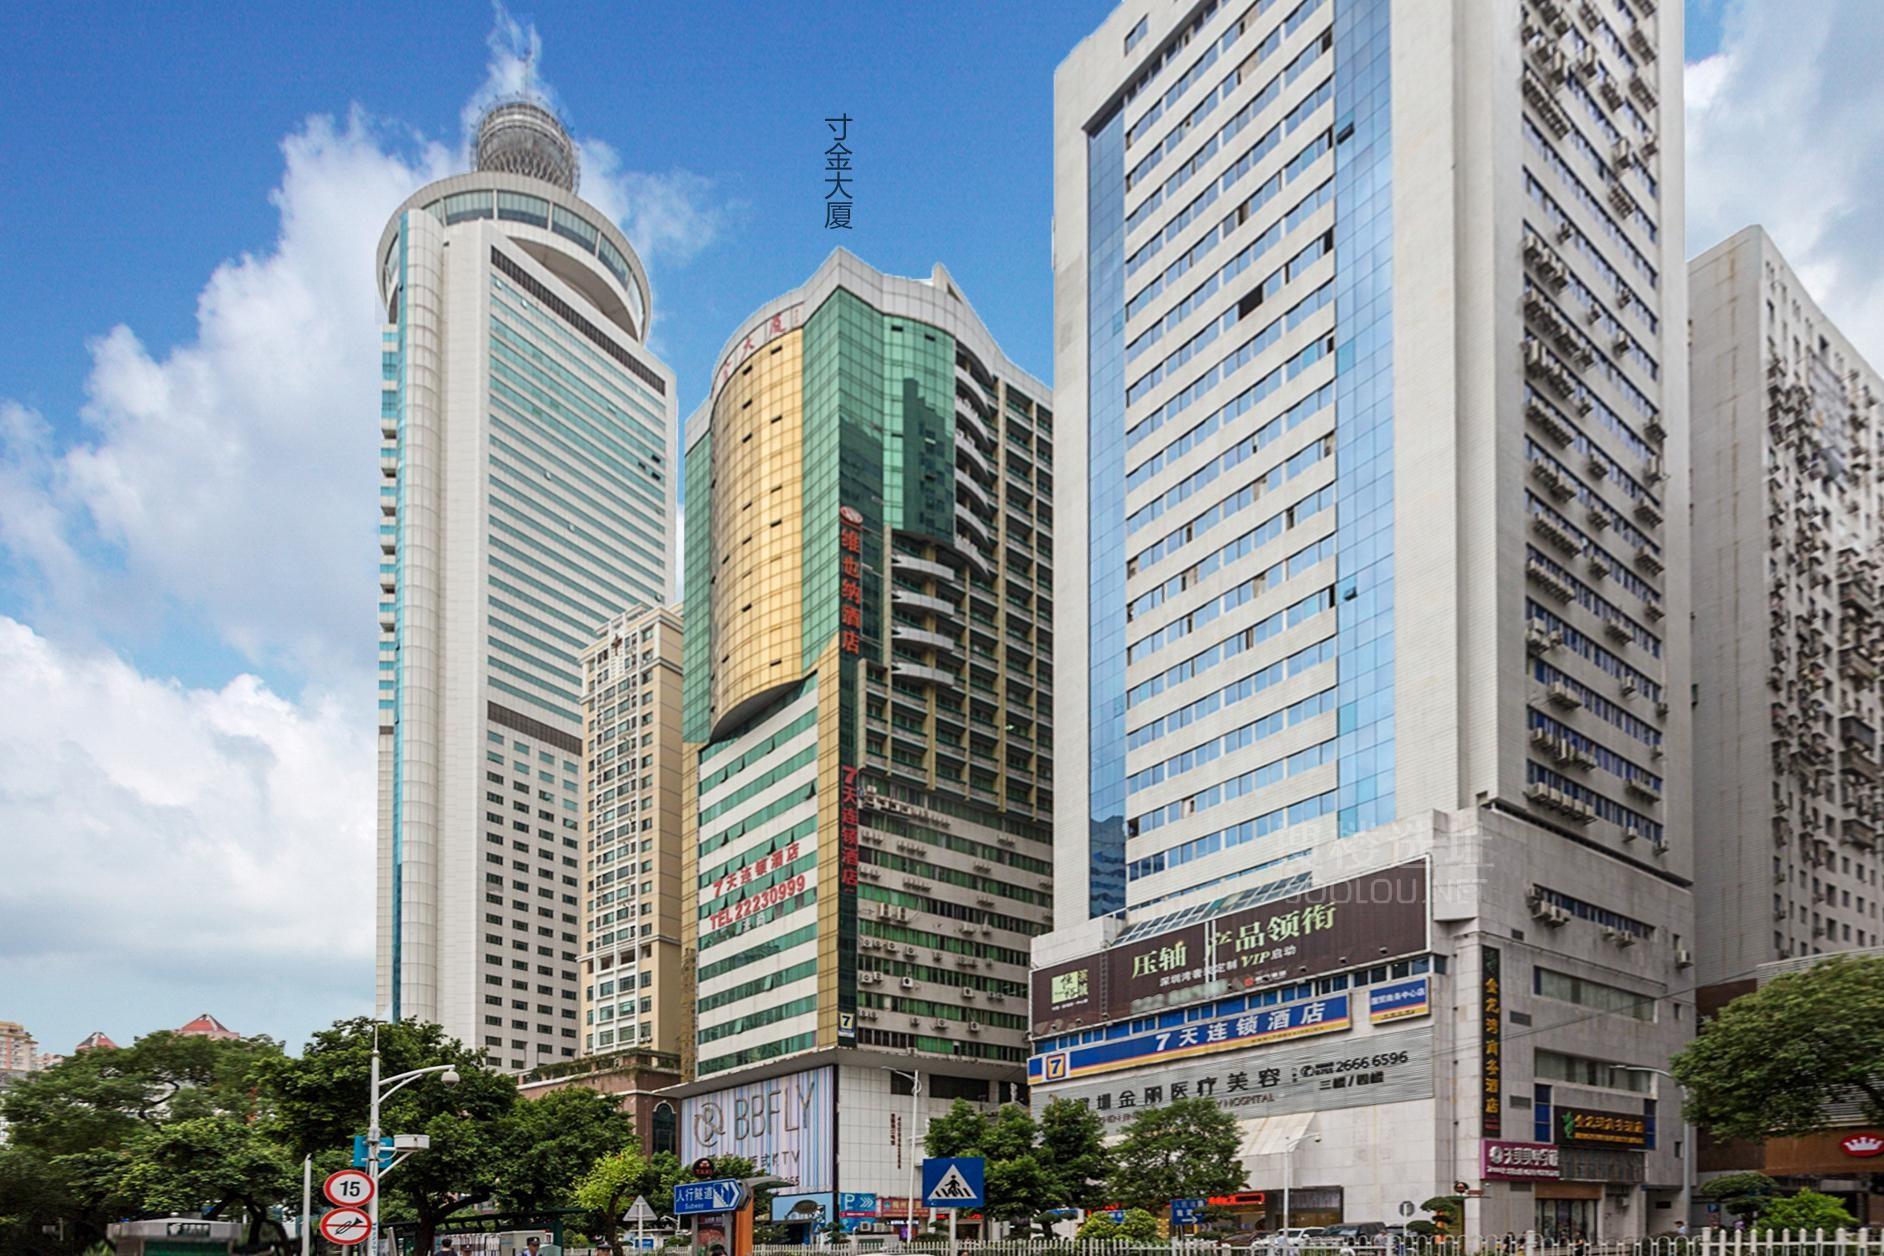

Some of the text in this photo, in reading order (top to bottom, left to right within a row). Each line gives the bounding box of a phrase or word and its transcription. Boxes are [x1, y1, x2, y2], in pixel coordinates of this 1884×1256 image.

[841, 528, 861, 656] 维也纳酒店
[842, 765, 858, 886] 7天连锁酒店
[713, 843, 800, 898] 7天连锁酒店
[710, 874, 806, 929] TEL 22230999
[1241, 950, 1271, 968] VIP
[1155, 1002, 1326, 1051] 7天连锁酒店
[1050, 1059, 1062, 1074] 7
[1336, 1057, 1370, 1073] 2666
[1372, 1051, 1408, 1067] 6596
[735, 1082, 815, 1141] BBFLY
[339, 1180, 361, 1197] 15
[844, 1194, 855, 1210] P
